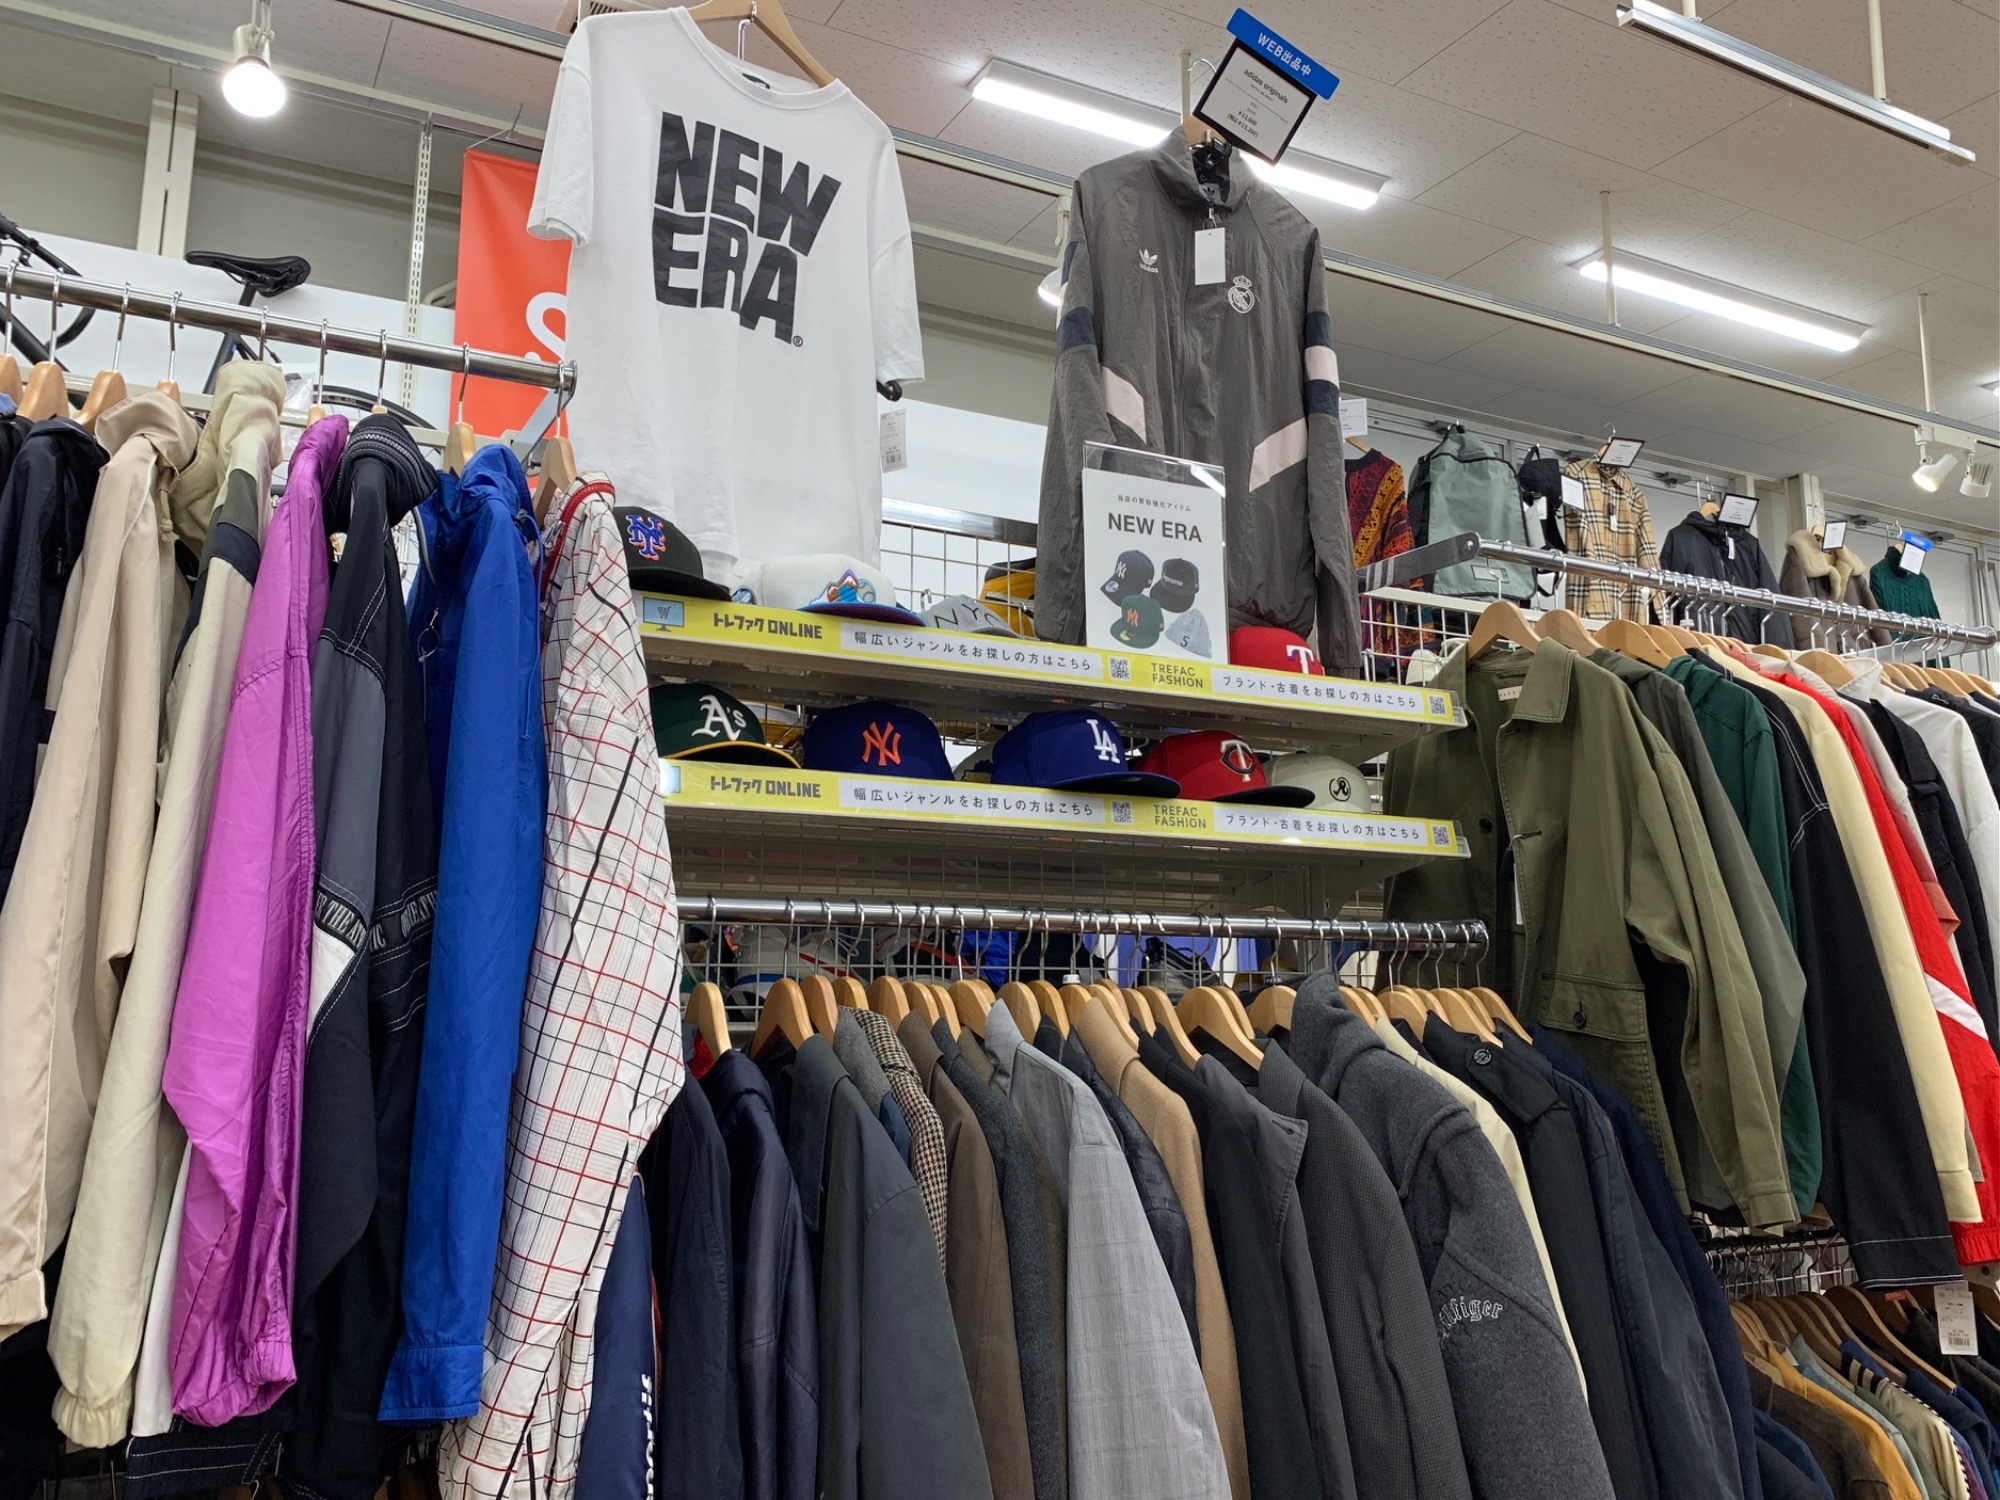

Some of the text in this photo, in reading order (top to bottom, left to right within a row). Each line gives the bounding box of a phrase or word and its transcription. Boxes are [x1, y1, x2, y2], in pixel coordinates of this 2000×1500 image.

[1257, 32, 1312, 76] WEB出品中
[1243, 69, 1264, 87] adidas
[1263, 81, 1289, 105] originals
[654, 111, 842, 257] NEW
[1108, 512, 1203, 543] NEW ERA
[713, 612, 823, 640] トレファク ONLINE
[1180, 635, 1191, 648] S
[854, 630, 1091, 671] 幅広いジャンルをお探しの方はこちら
[1285, 644, 1316, 675] T
[1151, 662, 1196, 678] TREFAC
[1152, 673, 1204, 689] FASHION
[1222, 675, 1416, 709] ブランド・古着をお探しの方はこちら
[861, 721, 902, 767] NY
[1086, 719, 1121, 764] LA
[710, 775, 821, 799] トレファク ONLINE
[853, 786, 1093, 816] 幅広いジャンルをお探しの方はこちら
[1153, 804, 1199, 817] TREFAC
[1154, 815, 1207, 829] FASHION
[1225, 814, 1420, 840] ブランド・古着をお探しの方はこちら
[322, 900, 355, 933] THE
